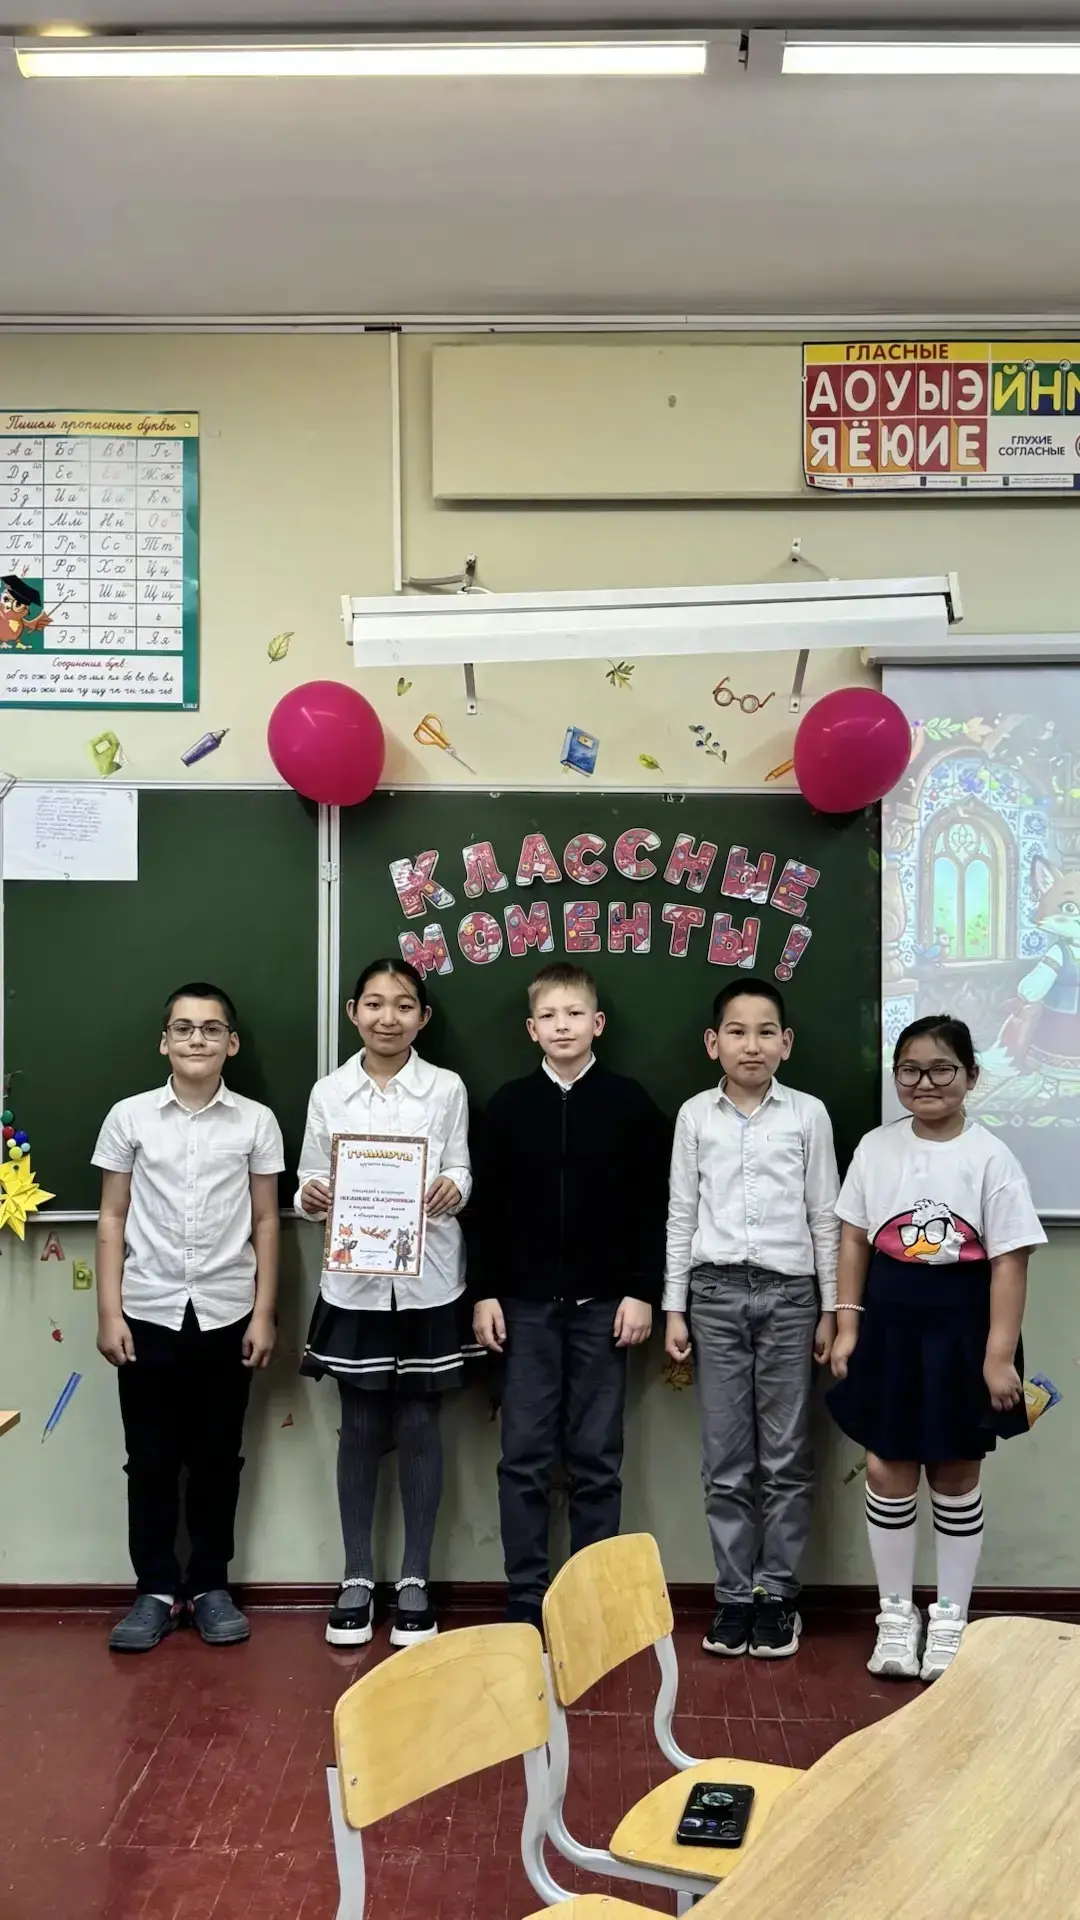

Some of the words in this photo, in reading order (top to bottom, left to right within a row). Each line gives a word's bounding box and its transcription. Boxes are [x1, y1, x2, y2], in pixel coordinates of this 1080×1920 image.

[845, 343, 950, 361] ГЛАСНЫЕ
[5, 414, 57, 431] Пишем
[61, 419, 132, 434] прописные
[137, 416, 177, 435] буквы
[1011, 435, 1053, 445] ГЛУХИЕ
[998, 446, 1066, 456] СОГЛАСНЫЕ
[52, 657, 102, 670] Соединения
[388, 827, 821, 920] КЛАССНЫЕ
[397, 900, 812, 982] МОМЕНТЫ!
[347, 1149, 413, 1162] ГРАМОТА
